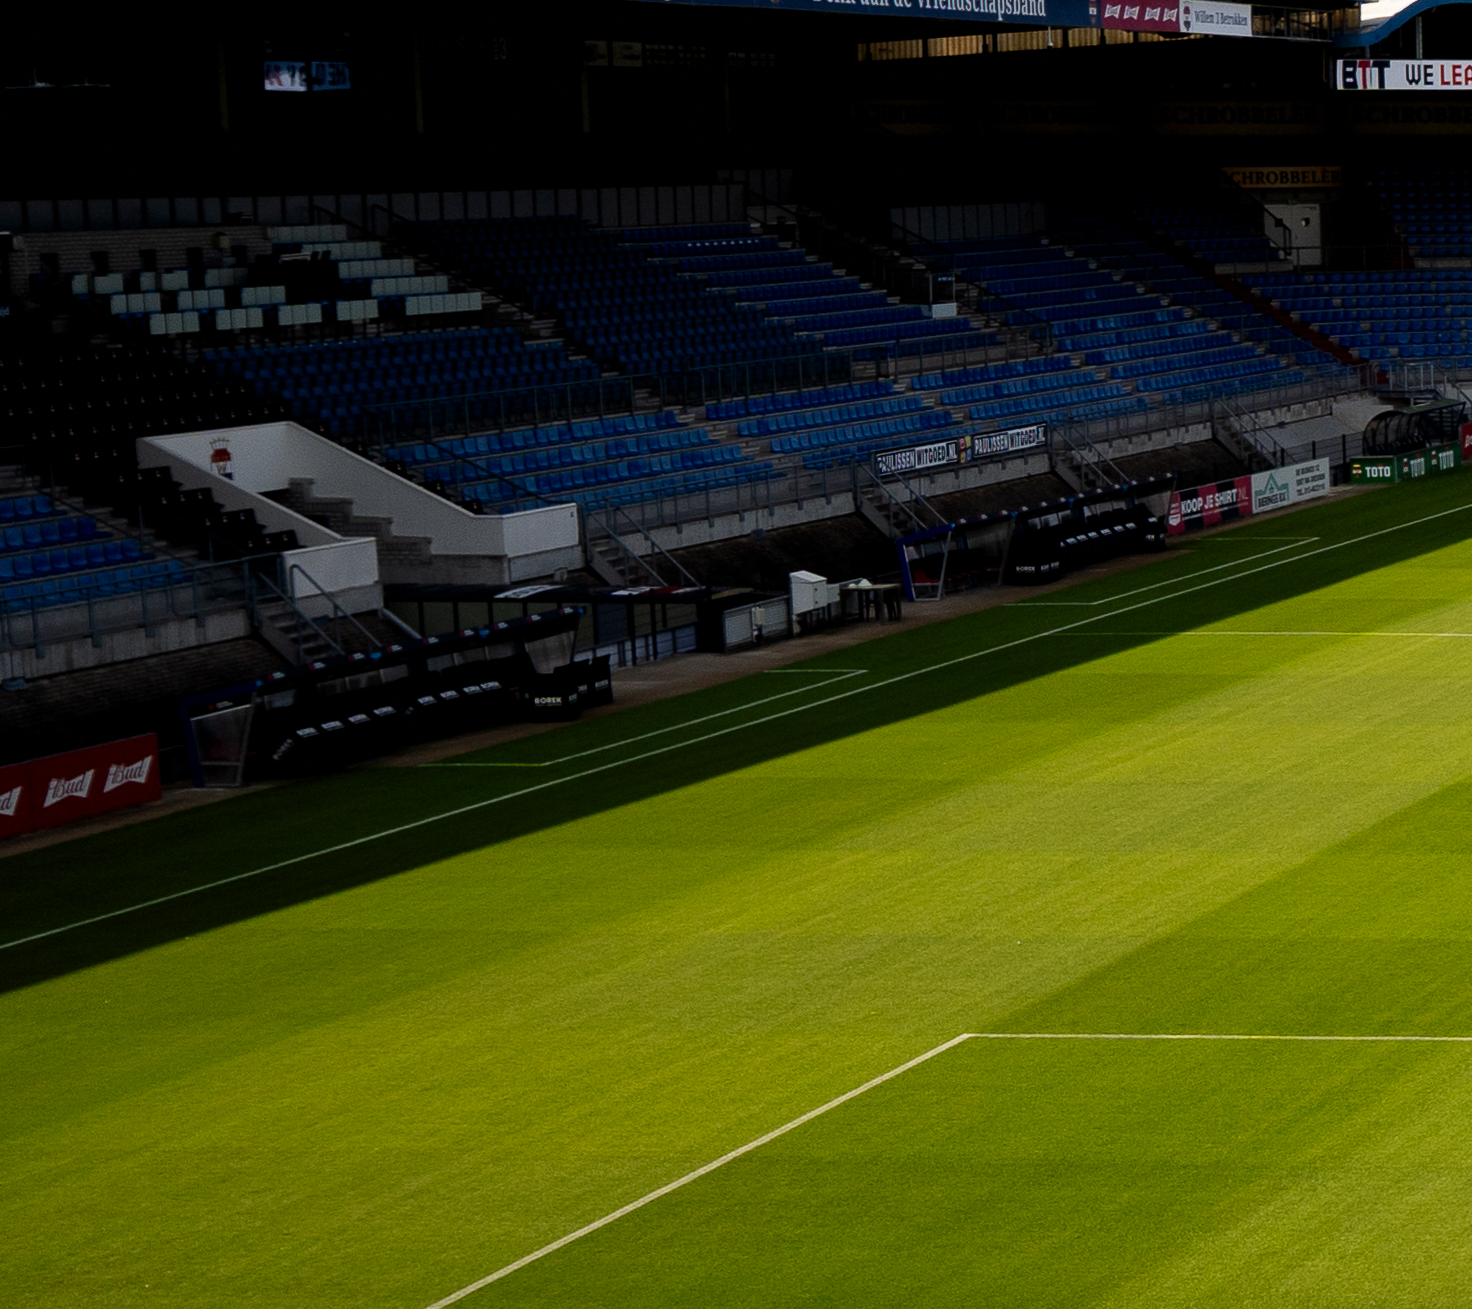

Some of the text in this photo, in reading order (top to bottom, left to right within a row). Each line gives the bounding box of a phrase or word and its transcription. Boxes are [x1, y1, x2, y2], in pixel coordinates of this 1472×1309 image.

[1342, 60, 1391, 89] BTT
[1405, 64, 1434, 87] WE
[975, 434, 1008, 456] PAULISSEN
[1365, 466, 1391, 478] TOTO
[1180, 496, 1203, 514] KOOP
[1204, 495, 1214, 509] JE
[51, 759, 145, 800] Bud Bud
